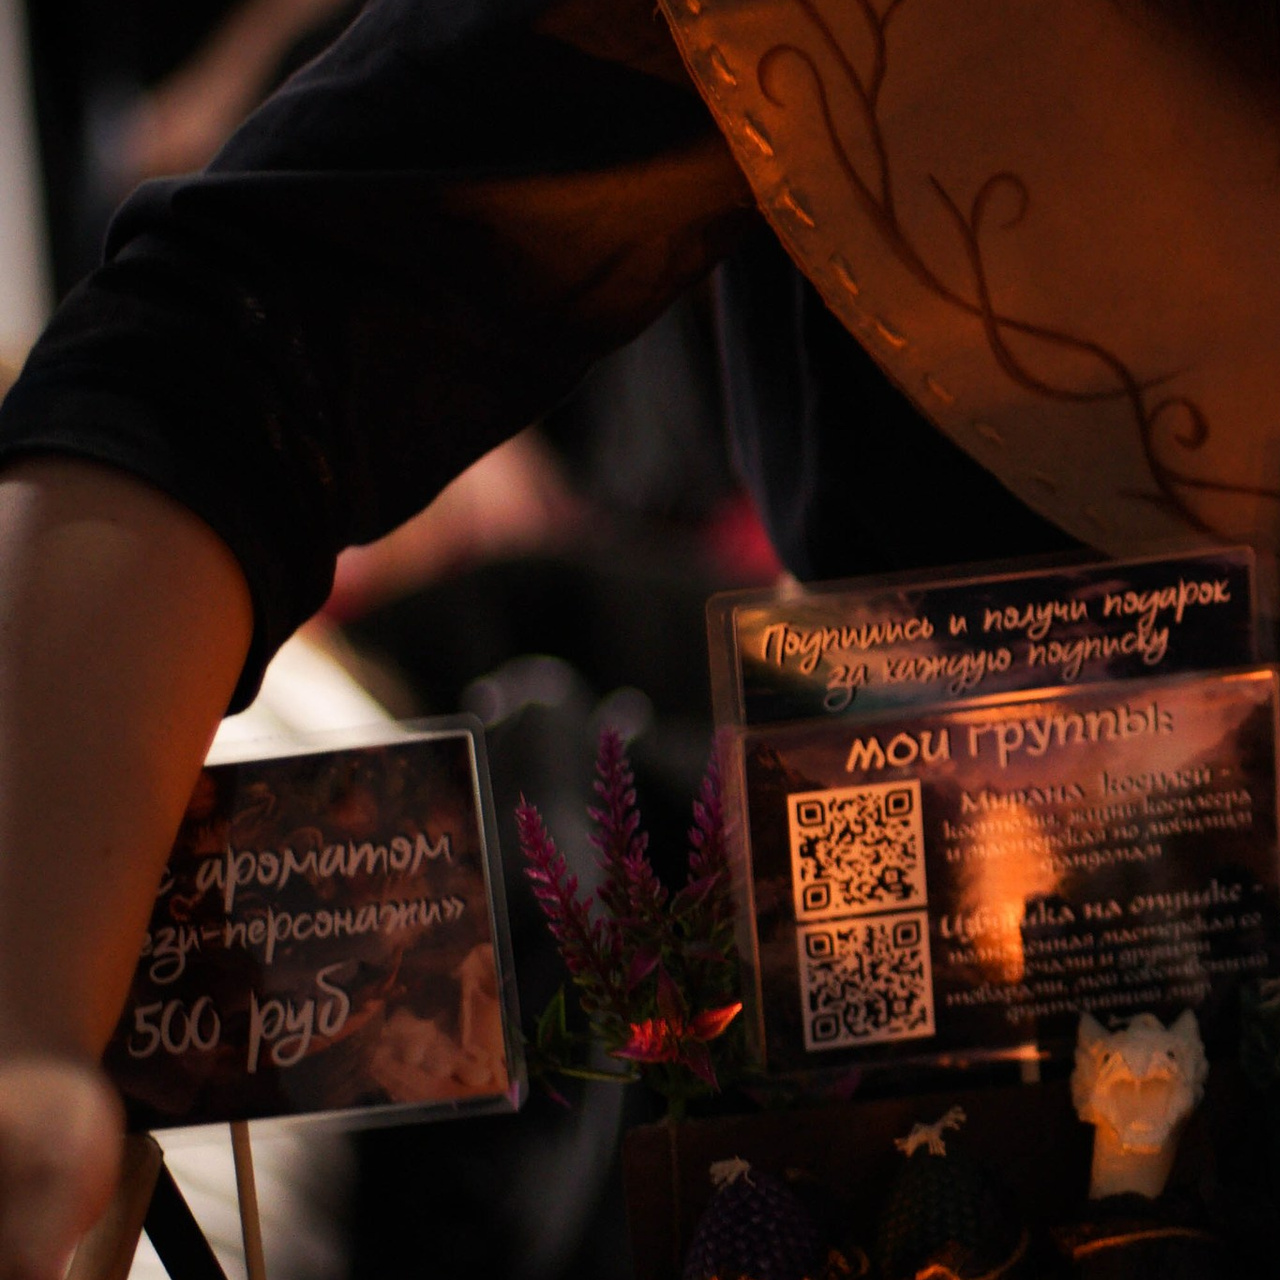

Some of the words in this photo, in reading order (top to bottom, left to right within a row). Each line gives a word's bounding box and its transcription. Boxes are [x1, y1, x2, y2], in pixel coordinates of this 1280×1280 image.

[761, 618, 935, 673] Подпишись
[948, 611, 969, 634] и
[984, 600, 1089, 642] получи
[1103, 575, 1233, 630] подарок
[824, 664, 868, 713] за
[882, 649, 1011, 694] каждую
[1028, 620, 1170, 681] подписку
[845, 727, 950, 773] мои
[968, 702, 1175, 767] группы:
[196, 831, 453, 914] ароматом
[1083, 899, 1123, 920] на
[129, 994, 222, 1059] 500
[248, 960, 357, 1074] руб
